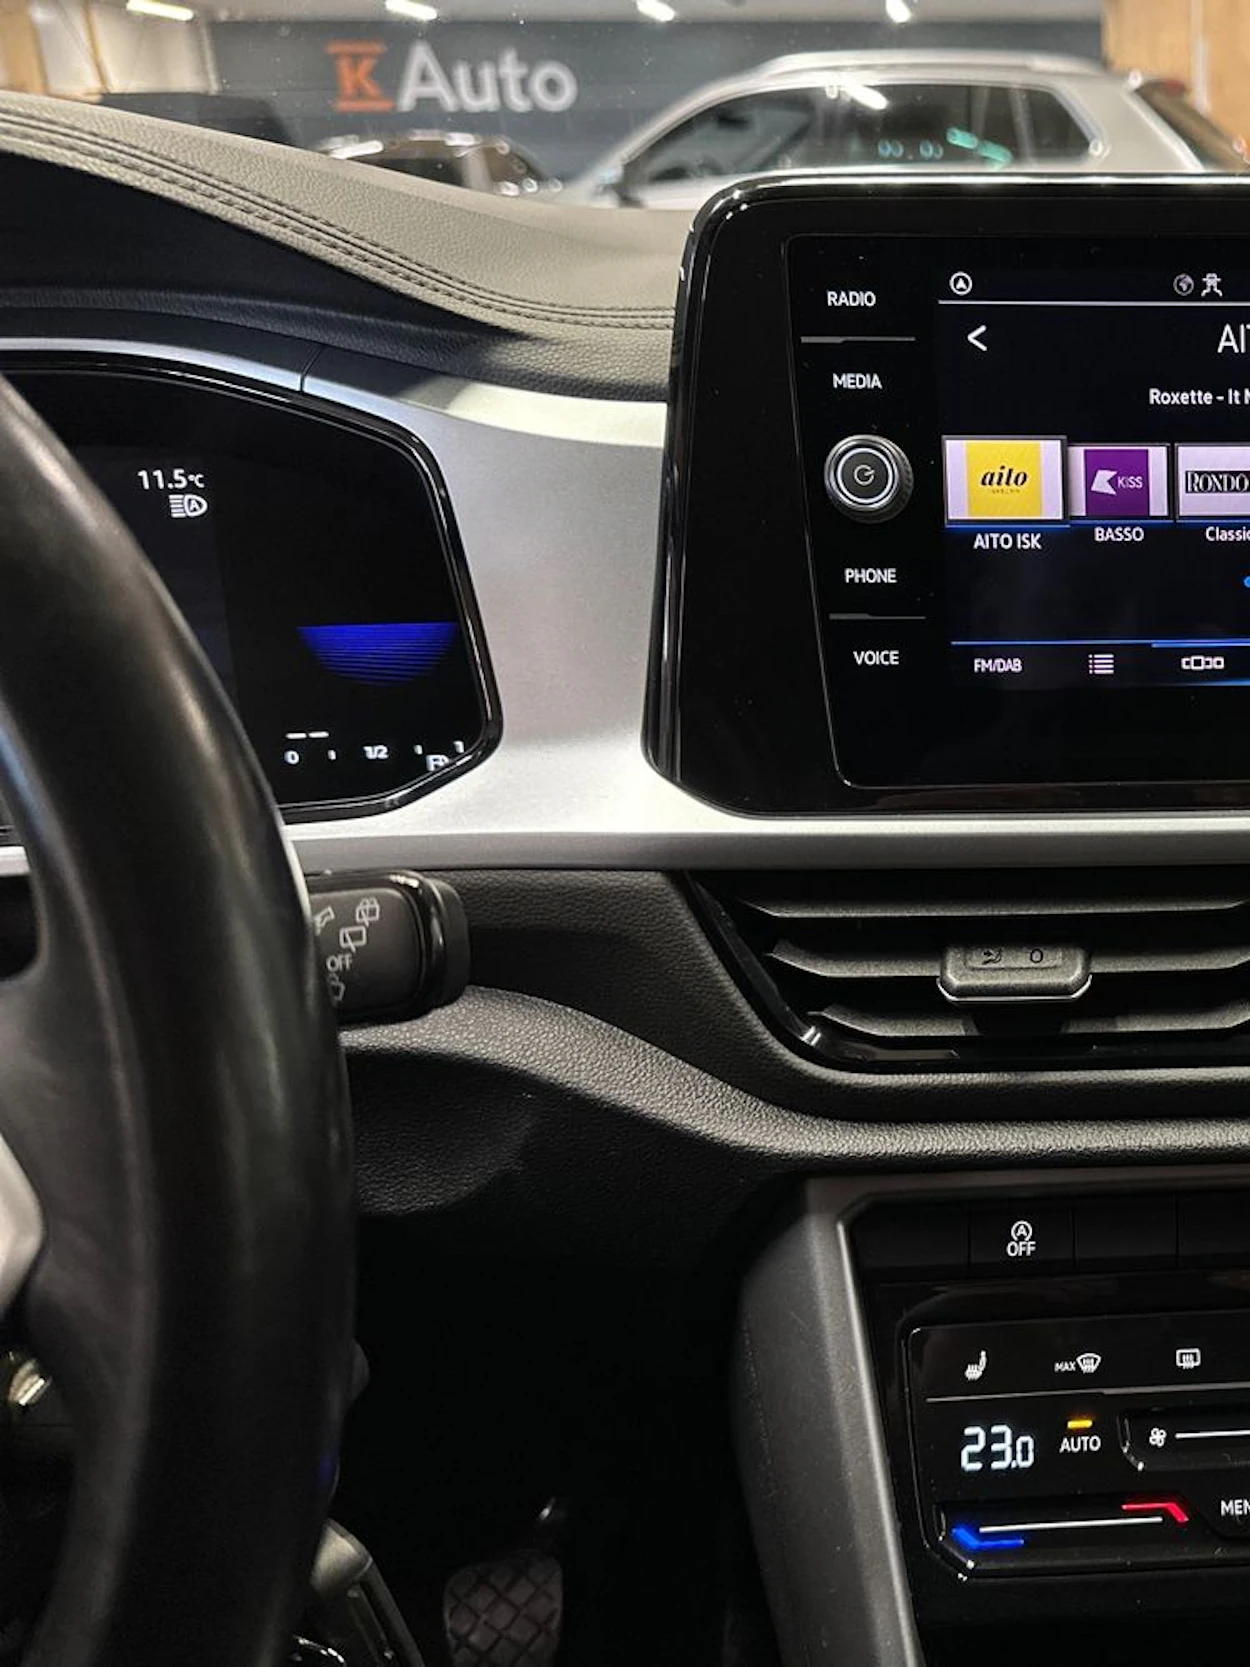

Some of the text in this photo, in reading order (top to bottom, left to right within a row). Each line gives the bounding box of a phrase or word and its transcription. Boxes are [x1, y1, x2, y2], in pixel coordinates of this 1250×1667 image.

[328, 38, 578, 112] K Auto
[826, 290, 877, 307] RADIO
[832, 372, 883, 390] MEDIA
[1149, 387, 1214, 405] Roxette
[1227, 387, 1241, 405] It
[1186, 472, 1250, 493] RONDO
[973, 532, 1042, 550] AITO ISK
[1094, 526, 1145, 542] BASSO
[844, 567, 897, 584] PHONE
[852, 649, 900, 666] VOICE
[973, 657, 1023, 673] FM/DAB
[326, 953, 352, 971] OFF
[1006, 1241, 1036, 1257] OFF
[1054, 1361, 1076, 1373] MAX
[960, 1424, 1035, 1472] 23.0
[1059, 1435, 1102, 1454] AUTO
